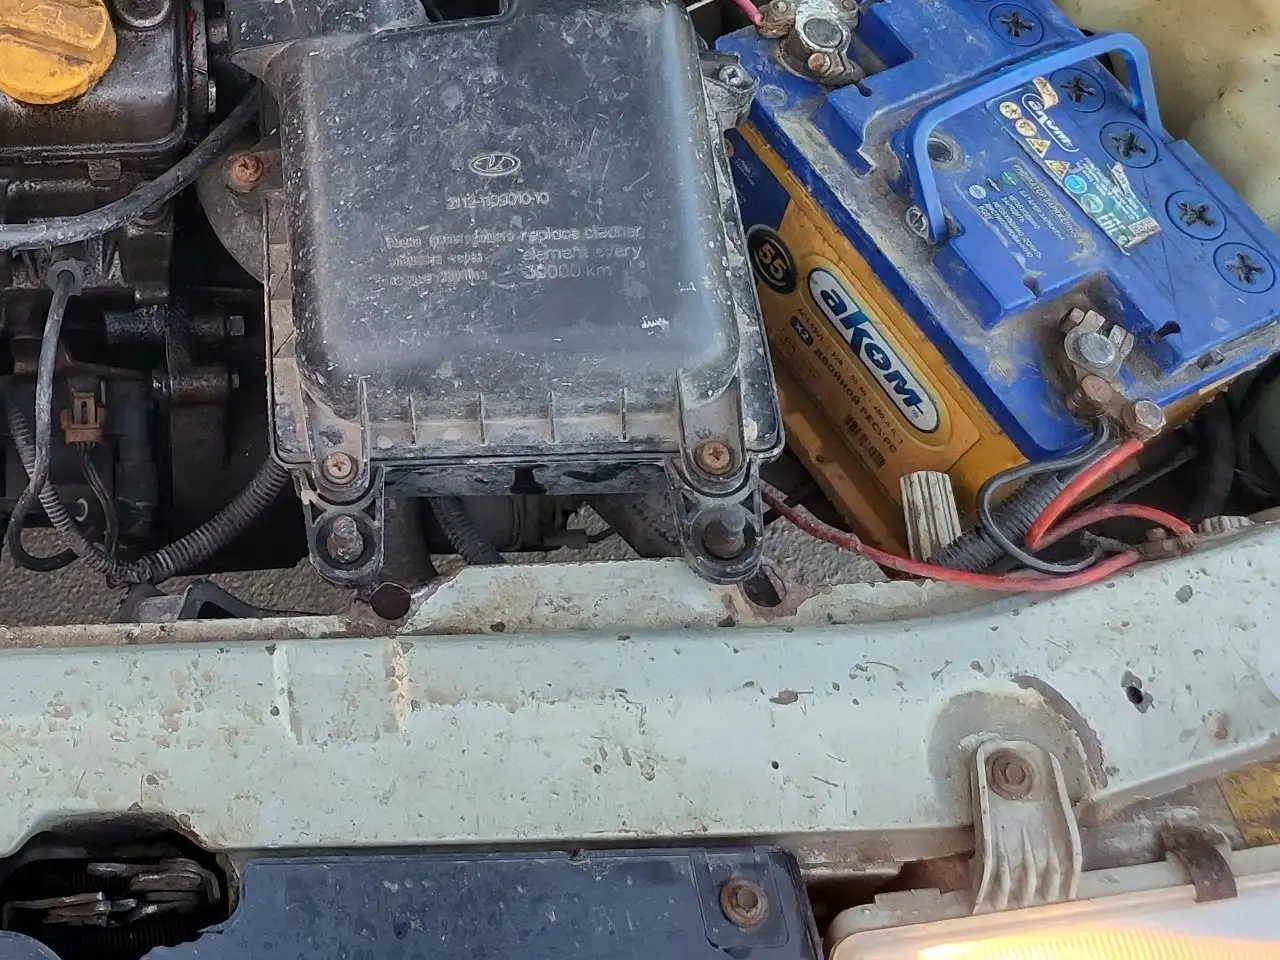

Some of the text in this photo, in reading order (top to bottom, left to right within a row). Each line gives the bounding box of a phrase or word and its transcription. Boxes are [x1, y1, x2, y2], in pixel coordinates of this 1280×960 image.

[520, 226, 581, 244] replace
[585, 264, 614, 277] km
[757, 242, 787, 281] 55
[812, 346, 898, 454] ДВОЙНОЙ РЕСУРС
